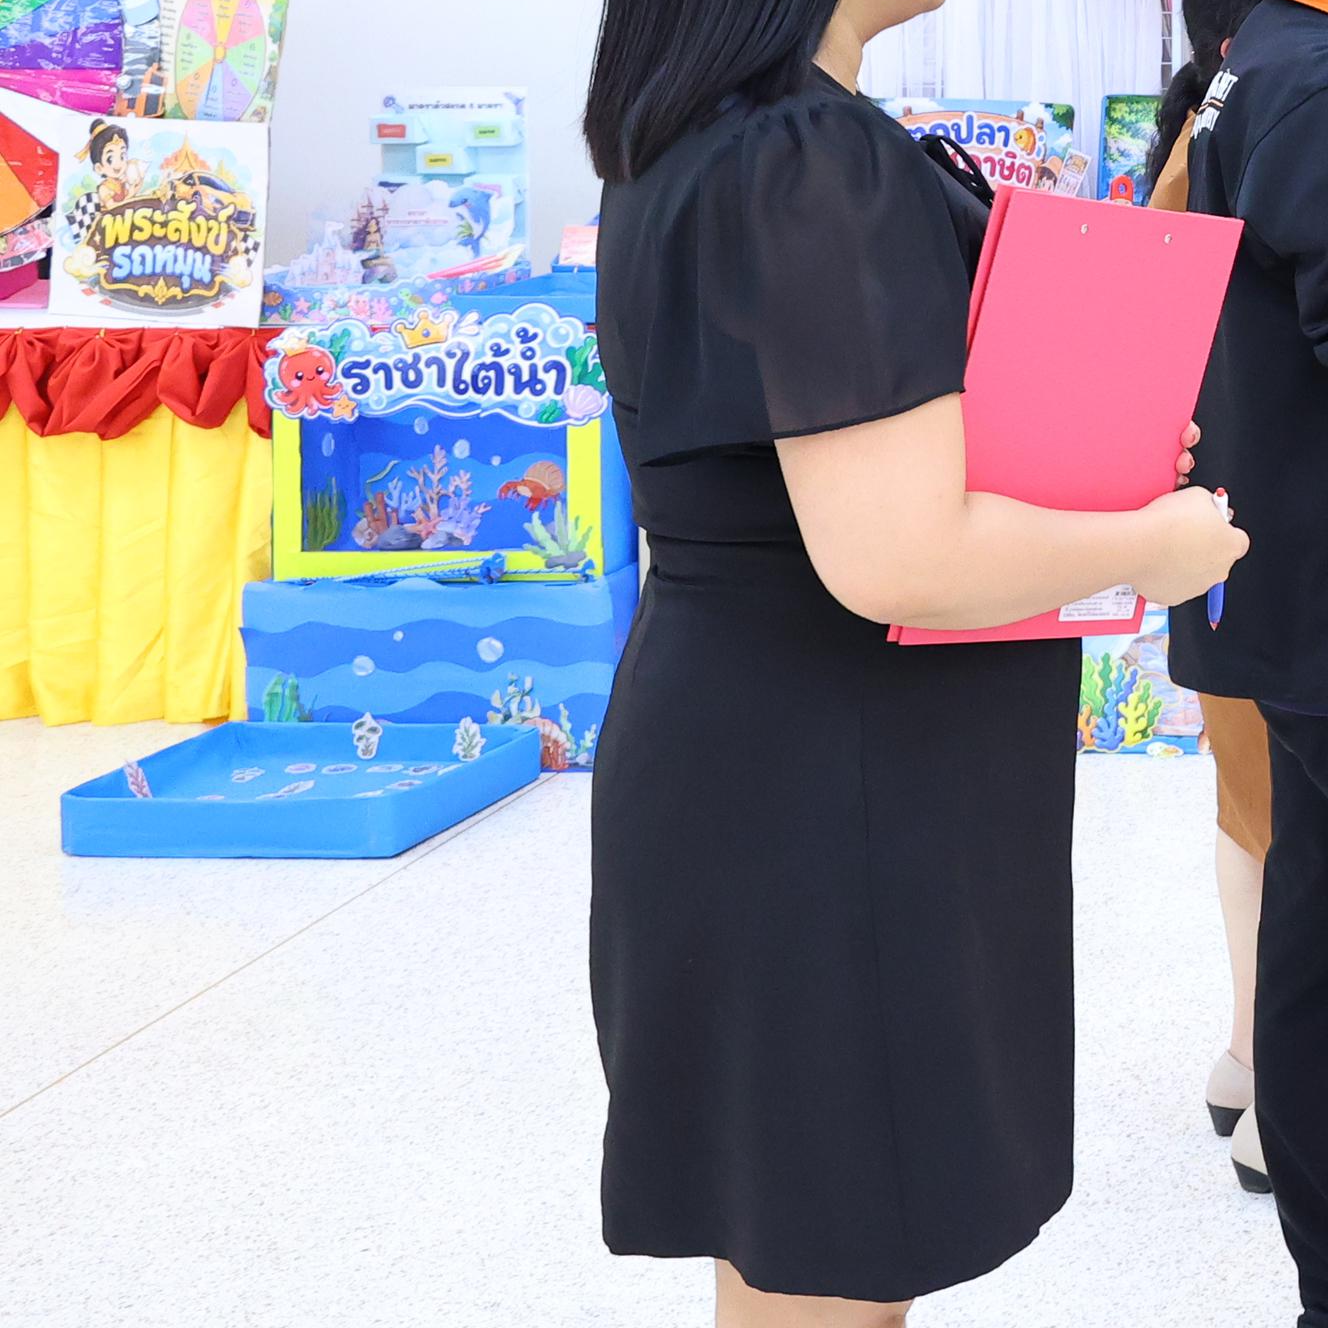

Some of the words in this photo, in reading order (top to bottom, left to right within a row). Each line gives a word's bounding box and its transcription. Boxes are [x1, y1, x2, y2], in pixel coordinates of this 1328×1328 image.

[102, 200, 236, 255] พระสังข์
[112, 244, 212, 291] รถหมุน
[343, 328, 569, 397] ราชาใต้น้ำ
